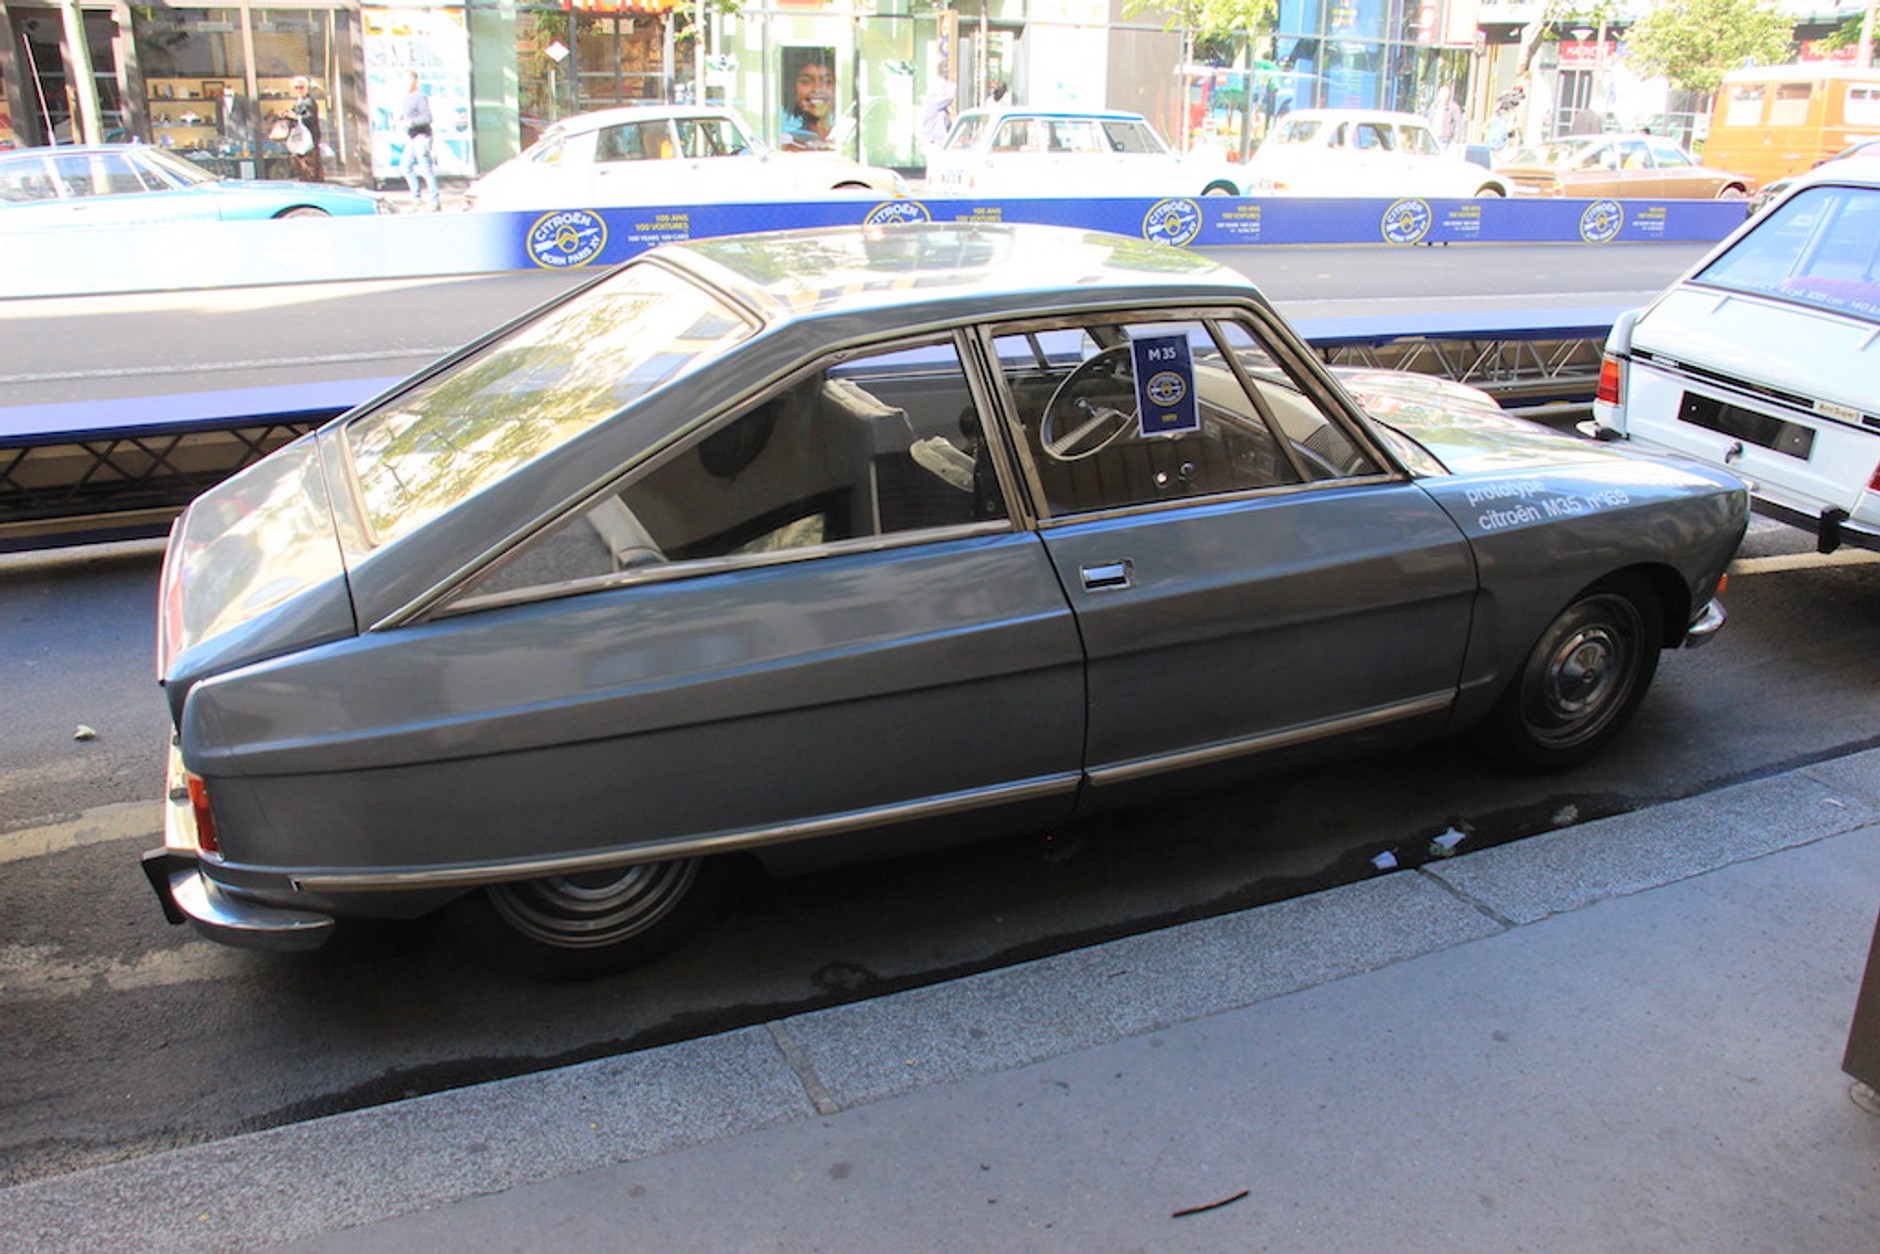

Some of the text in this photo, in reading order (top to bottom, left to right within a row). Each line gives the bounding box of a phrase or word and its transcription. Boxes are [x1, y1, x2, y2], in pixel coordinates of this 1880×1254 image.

[535, 212, 592, 241] CITROËN
[651, 223, 689, 231] VOITURES
[541, 253, 566, 265] BORN
[568, 248, 592, 264] PARIS
[1148, 347, 1176, 361] M 35
[1465, 480, 1545, 507] prototype
[1542, 496, 1583, 518] M35
